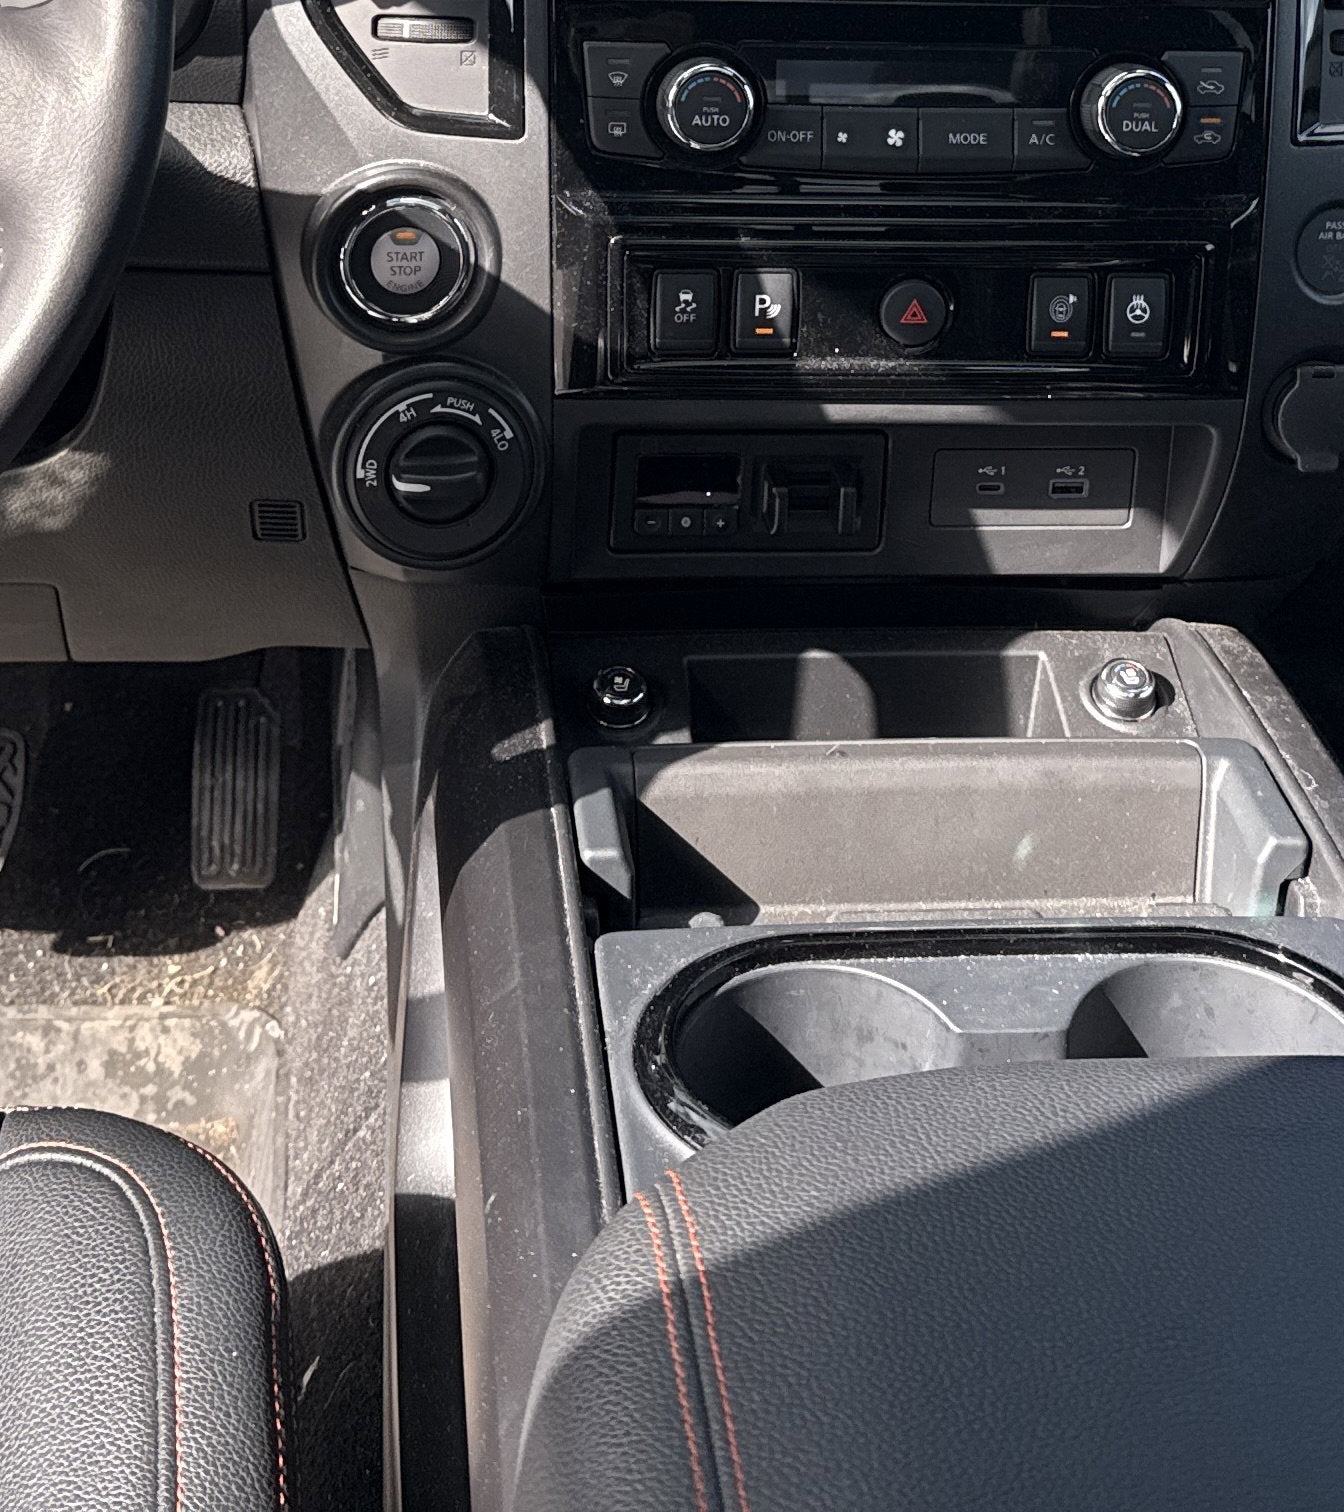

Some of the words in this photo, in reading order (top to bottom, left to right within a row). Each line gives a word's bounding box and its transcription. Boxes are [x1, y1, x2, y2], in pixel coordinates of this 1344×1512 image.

[691, 115, 730, 127] AUTO
[1122, 120, 1159, 133] DUAL
[767, 129, 815, 143] ON-OFF
[948, 133, 988, 145] MODE
[1028, 133, 1056, 146] A/C
[1318, 231, 1334, 240] AIR
[386, 251, 425, 263] START
[389, 265, 422, 276] STOP
[385, 279, 425, 293] ENGINE
[754, 294, 772, 317] P
[674, 313, 697, 324] OFF
[446, 396, 475, 412] PUSH
[398, 406, 417, 423] 4H
[490, 428, 509, 451] 4LO
[365, 459, 378, 487] 2WD
[1077, 465, 1086, 476] 2
